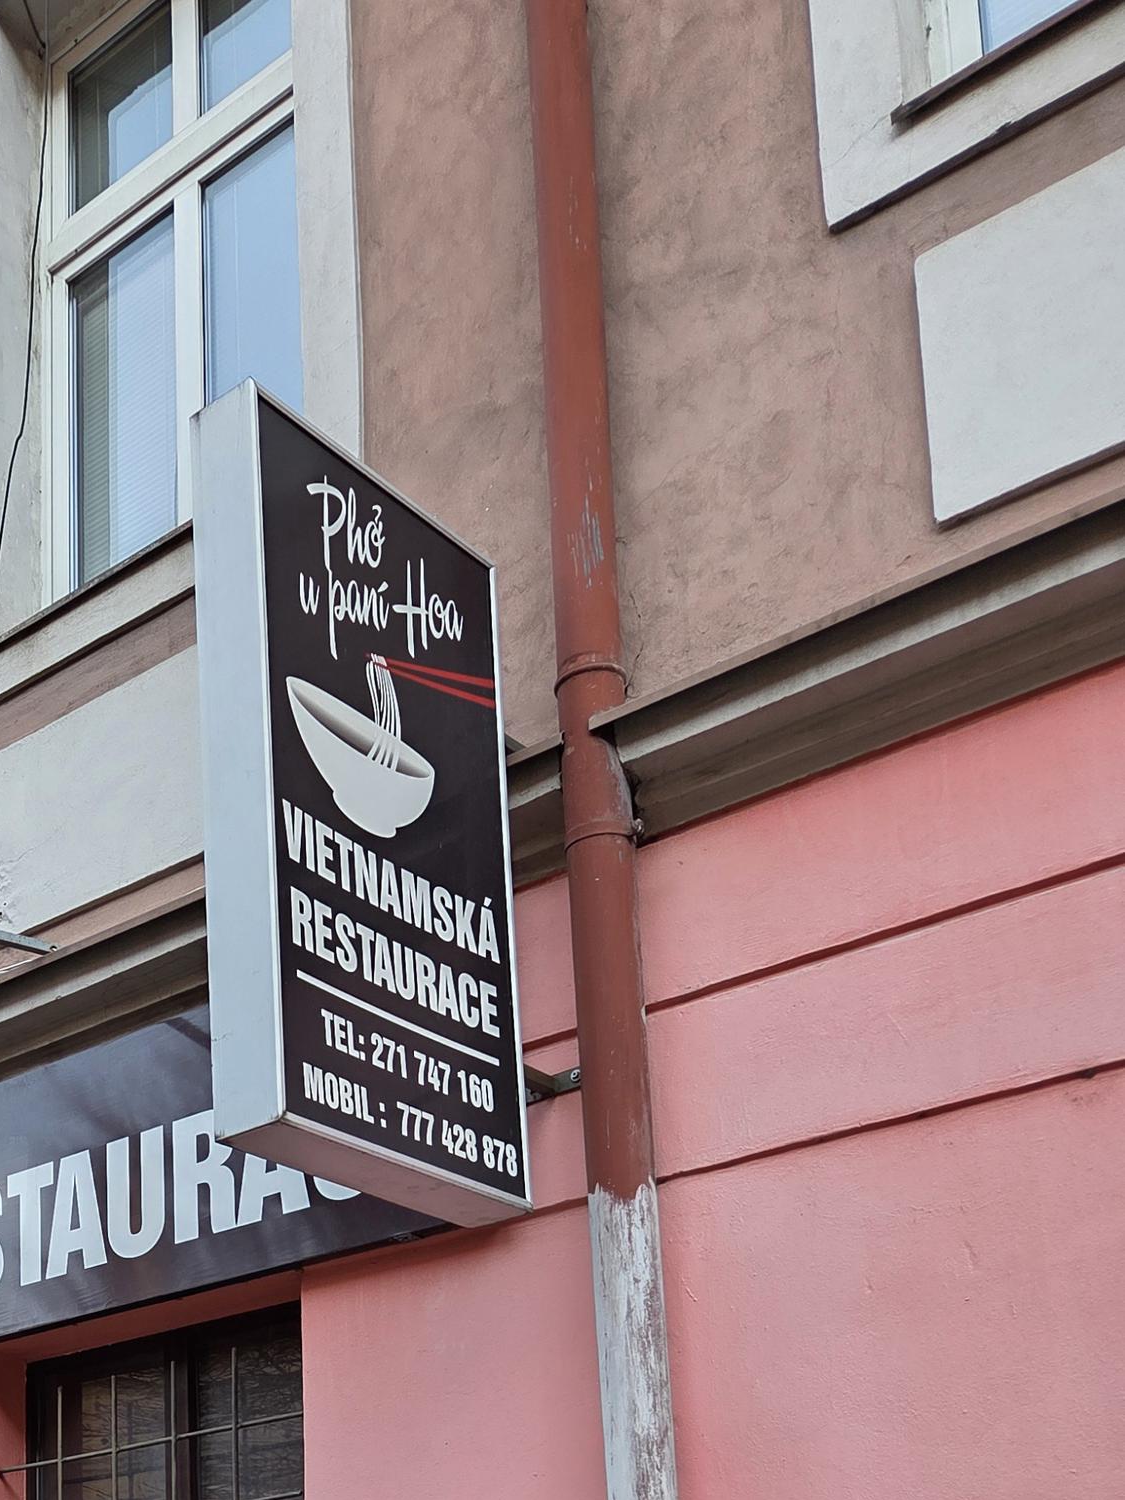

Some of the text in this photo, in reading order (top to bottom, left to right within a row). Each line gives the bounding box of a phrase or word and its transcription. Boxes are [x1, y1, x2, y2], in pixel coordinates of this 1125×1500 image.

[299, 556, 464, 660] u paní Hoa
[282, 798, 500, 964] VIETNAMSKÁ
[290, 885, 500, 1039] RESTAURACE
[321, 1008, 494, 1112] TEL: 271 747 160
[303, 1062, 374, 1124] MOBIL
[396, 1101, 434, 1146] 777
[441, 1119, 478, 1163] 428
[482, 1135, 518, 1177] 878
